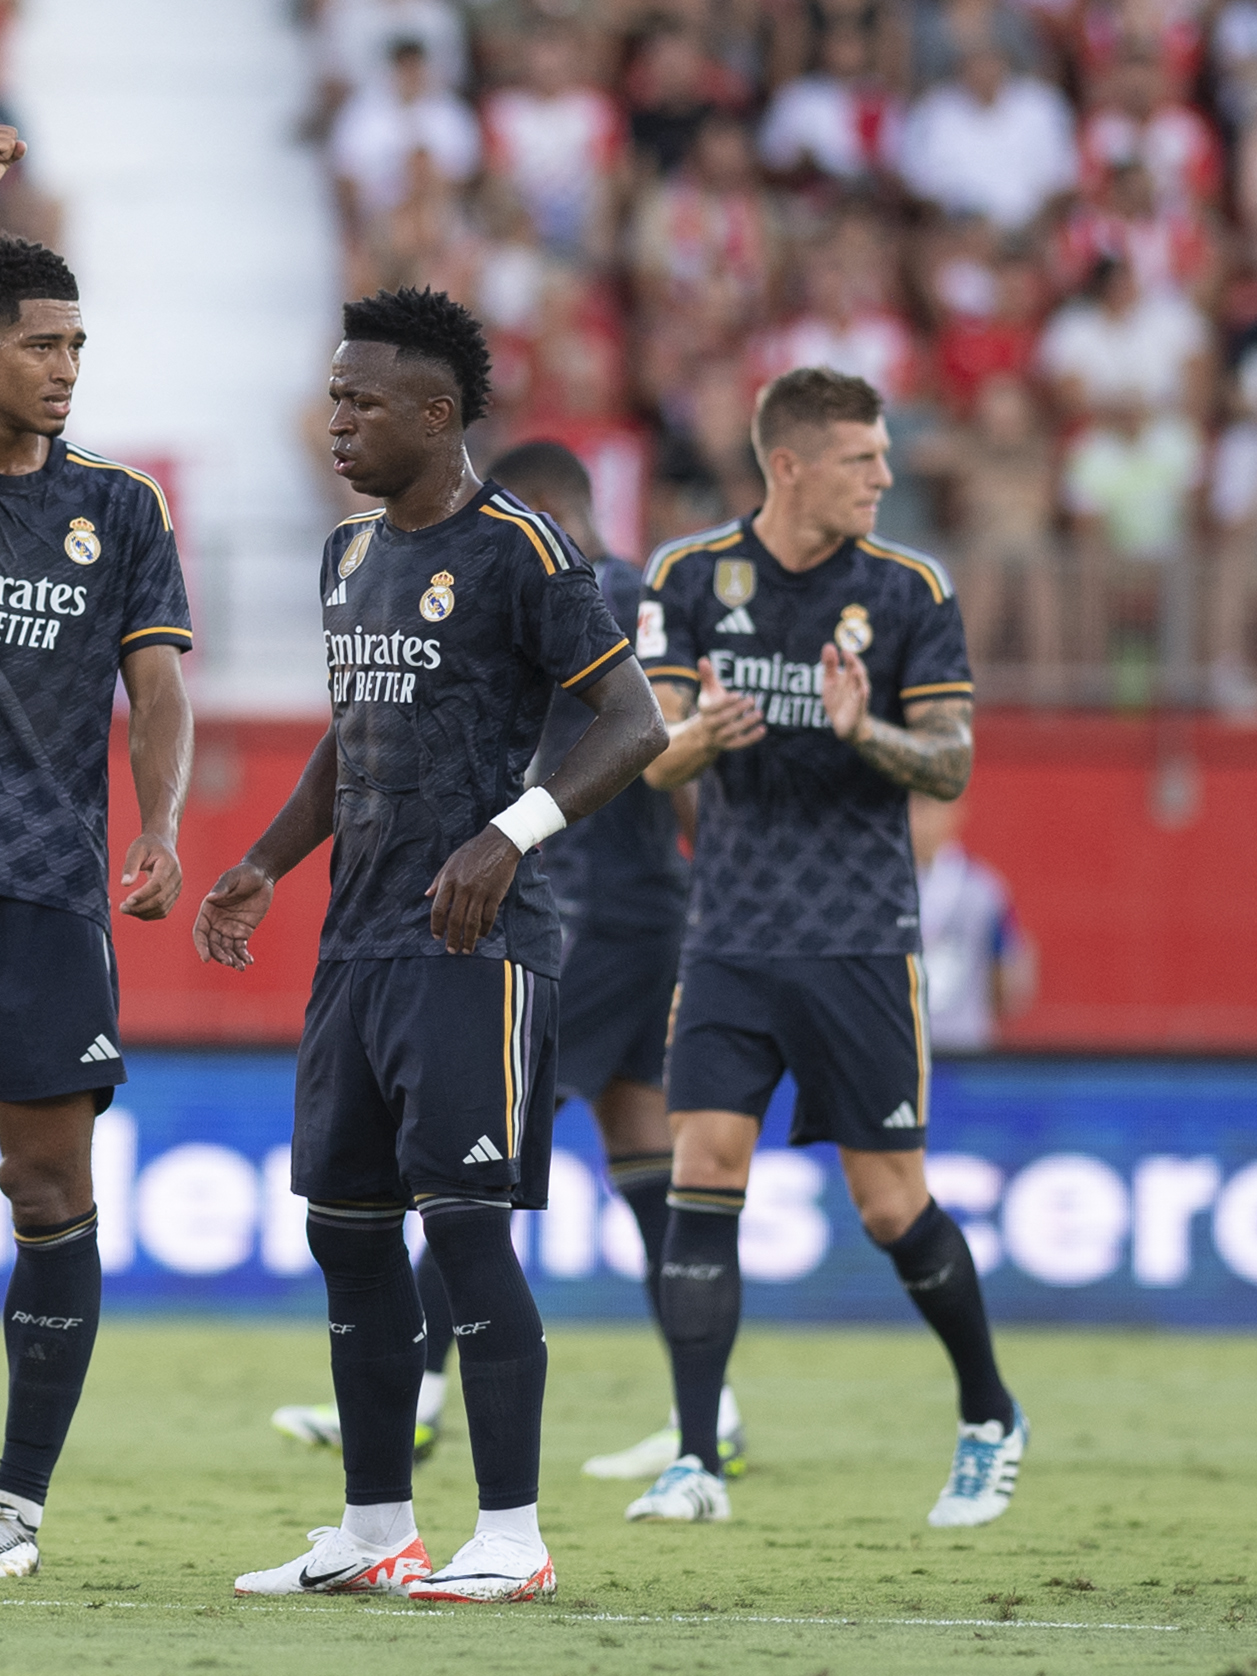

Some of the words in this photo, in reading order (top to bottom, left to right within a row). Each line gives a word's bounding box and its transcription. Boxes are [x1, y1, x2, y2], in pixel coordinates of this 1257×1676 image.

[323, 625, 441, 669] Emirates
[354, 671, 416, 703] BETTER
[11, 1310, 83, 1330] RMCF
